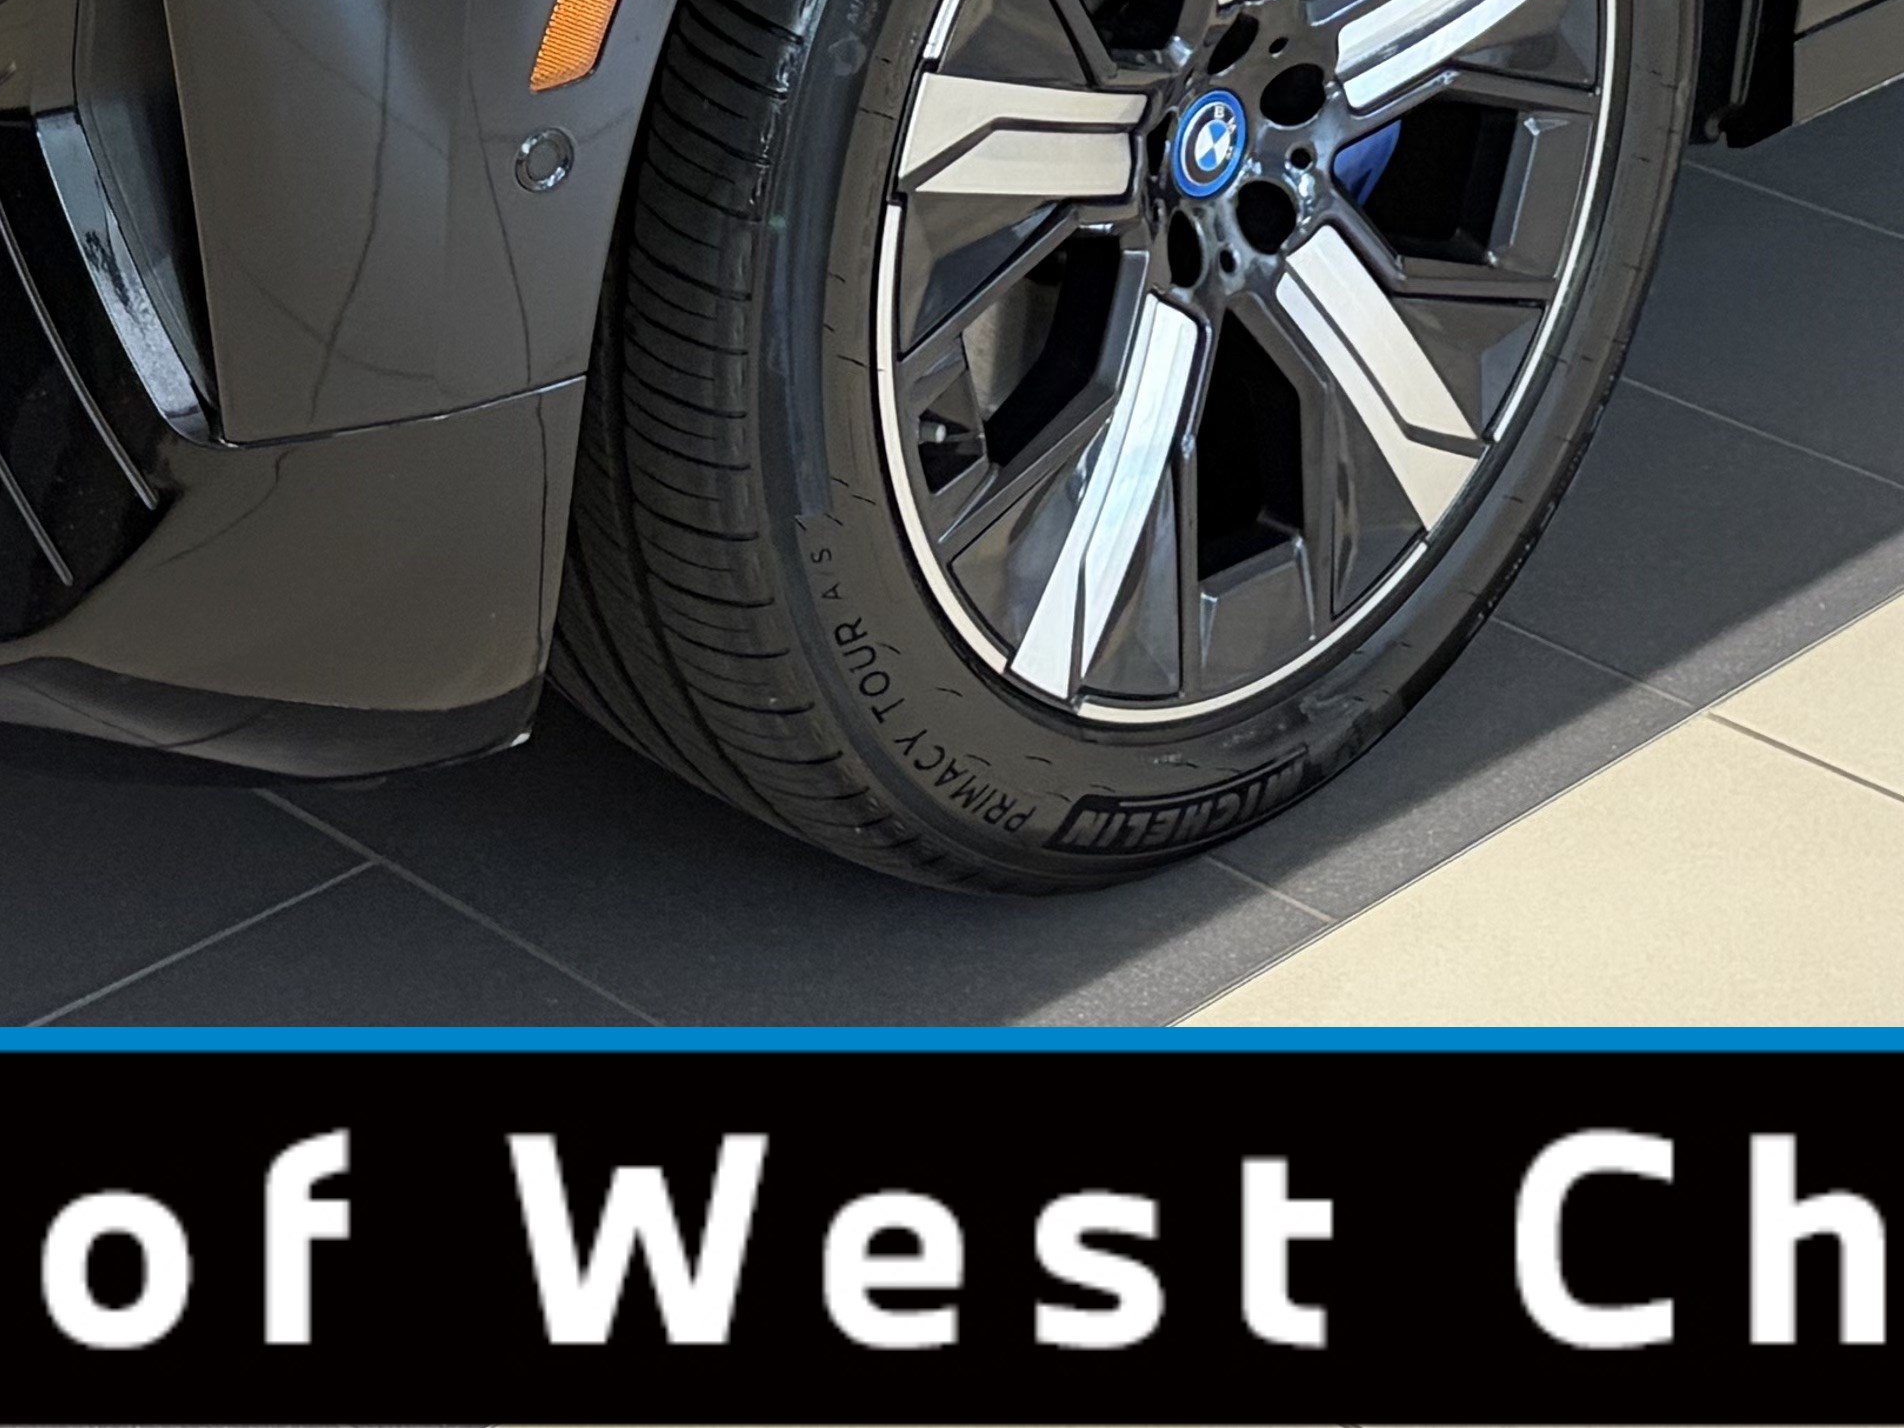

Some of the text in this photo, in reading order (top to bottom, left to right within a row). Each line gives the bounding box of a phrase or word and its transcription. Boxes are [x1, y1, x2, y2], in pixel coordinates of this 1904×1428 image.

[834, 617, 908, 723] TOUR
[896, 727, 1038, 834] PRIMACY
[1066, 756, 1305, 850] MICHELIN
